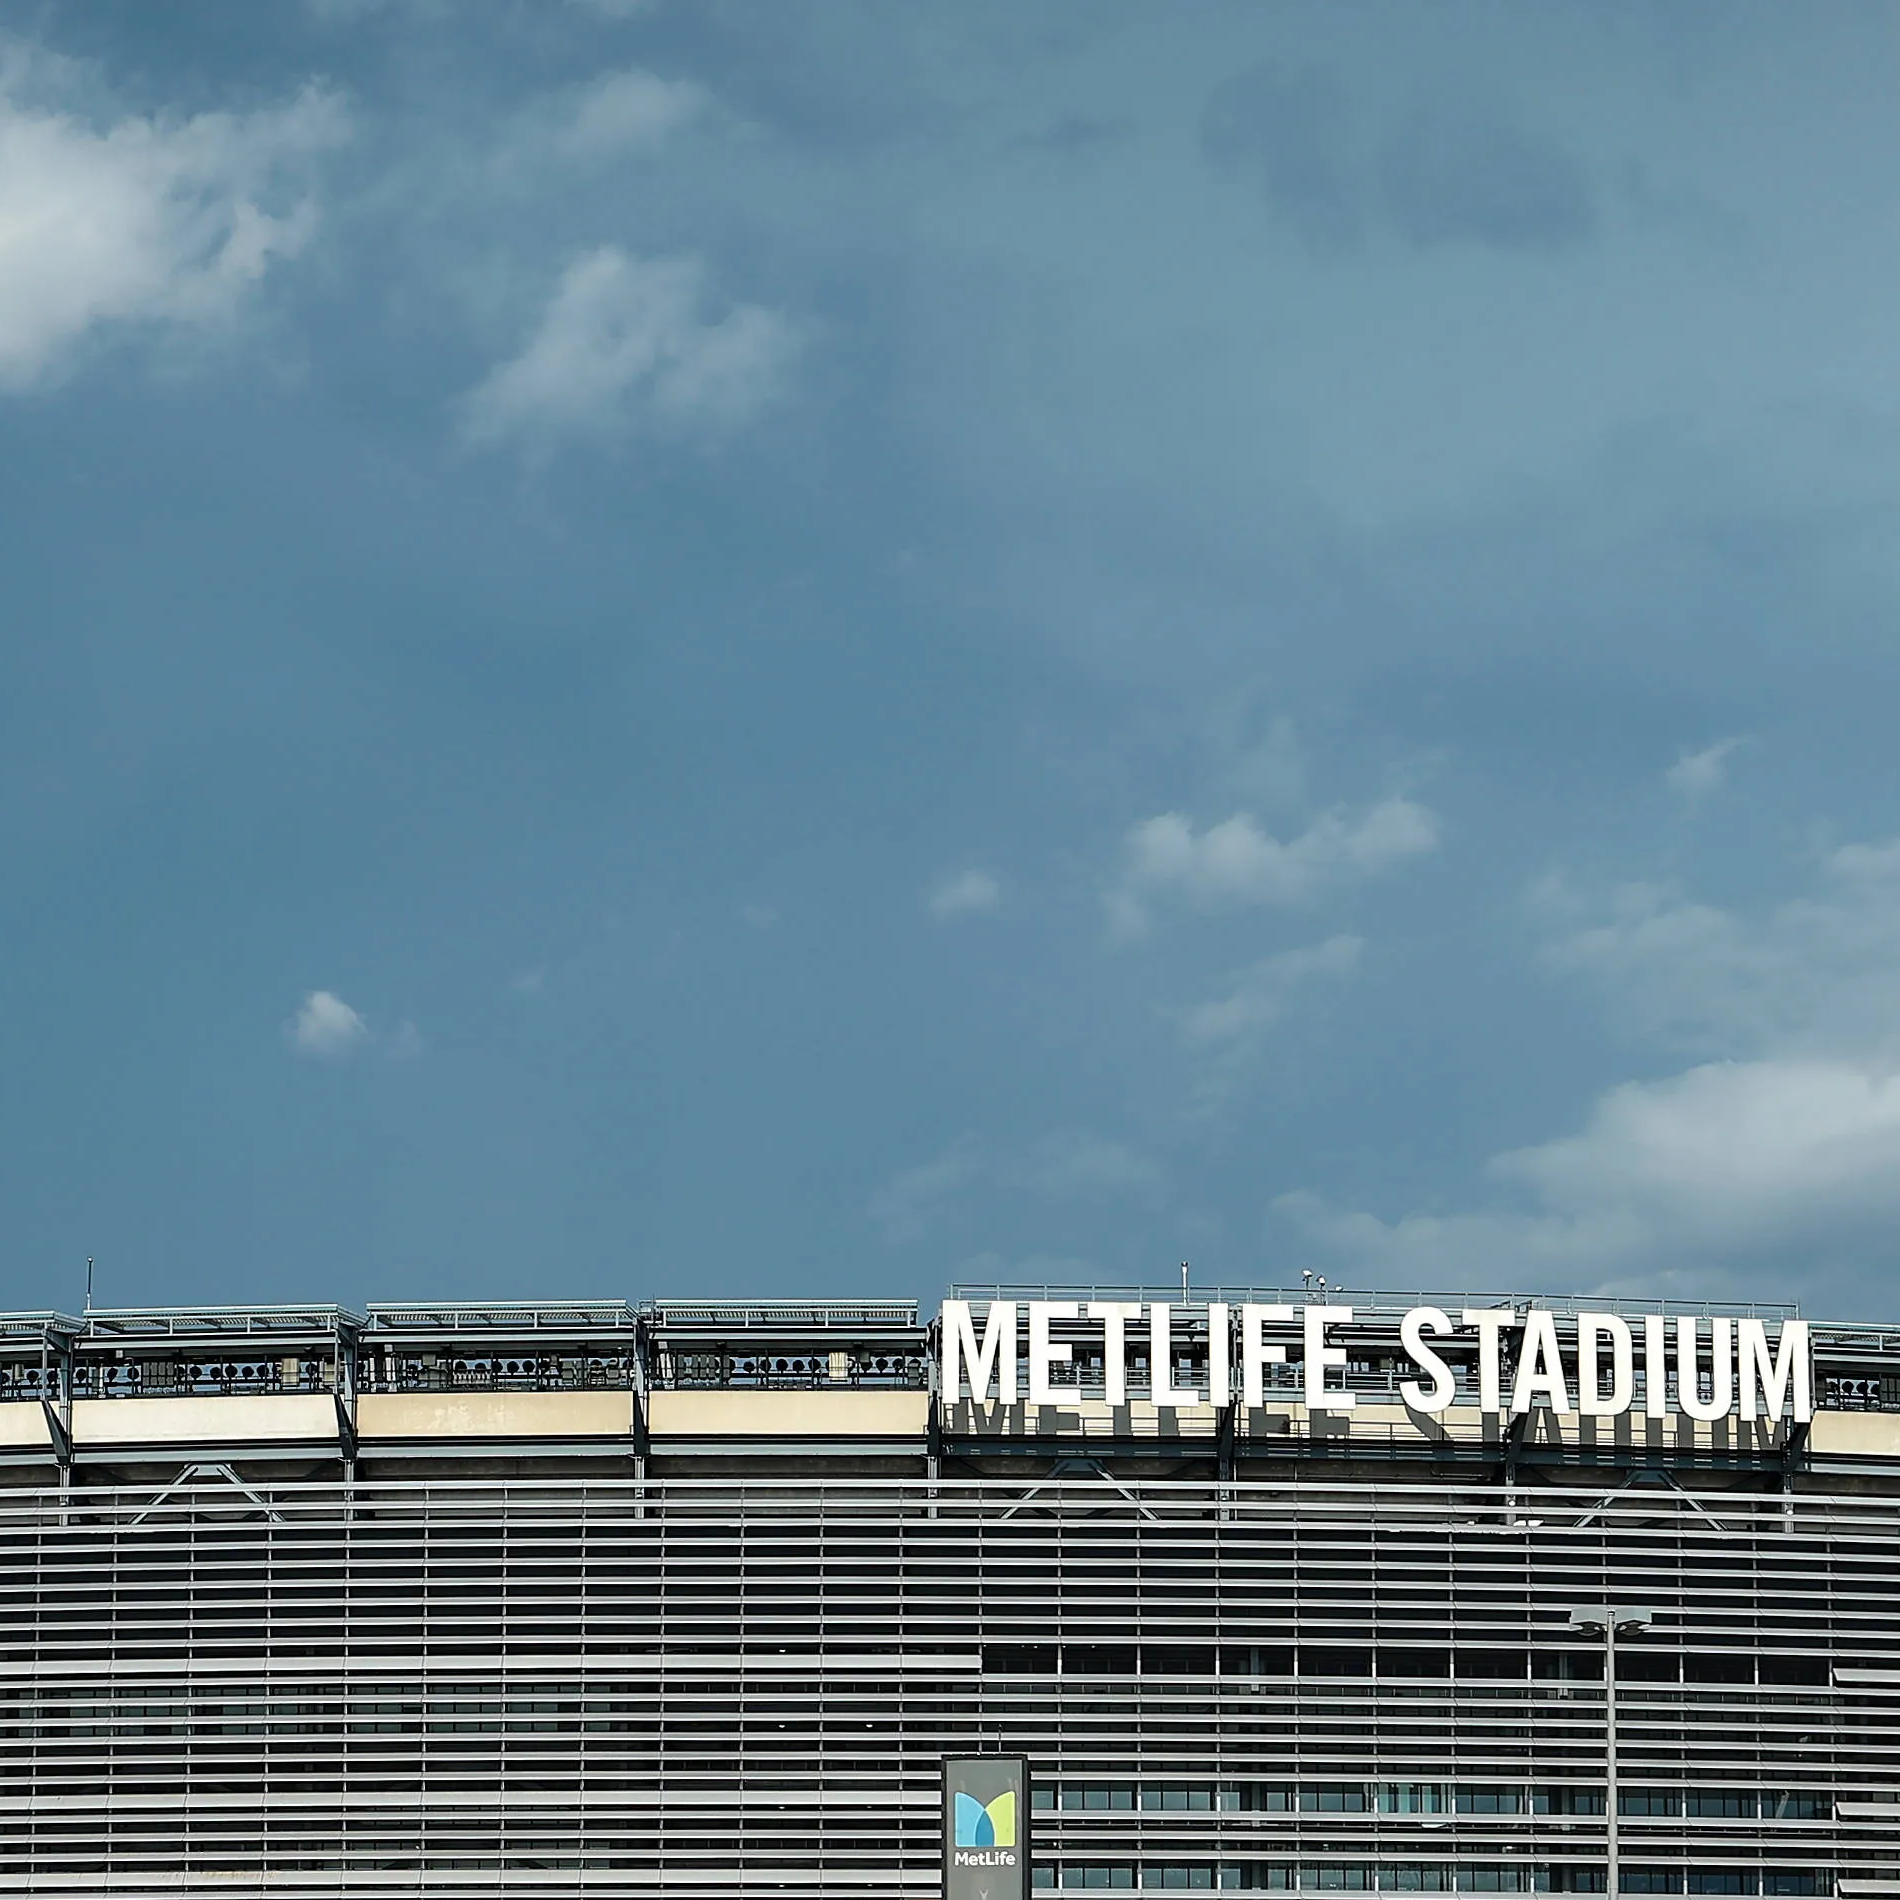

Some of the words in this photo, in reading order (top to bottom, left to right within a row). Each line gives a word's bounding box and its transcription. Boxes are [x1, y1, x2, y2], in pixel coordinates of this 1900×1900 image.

[941, 1300, 1357, 1411] METLIFE
[1398, 1306, 1814, 1423] STADIUM
[954, 1851, 1016, 1867] MetLife
